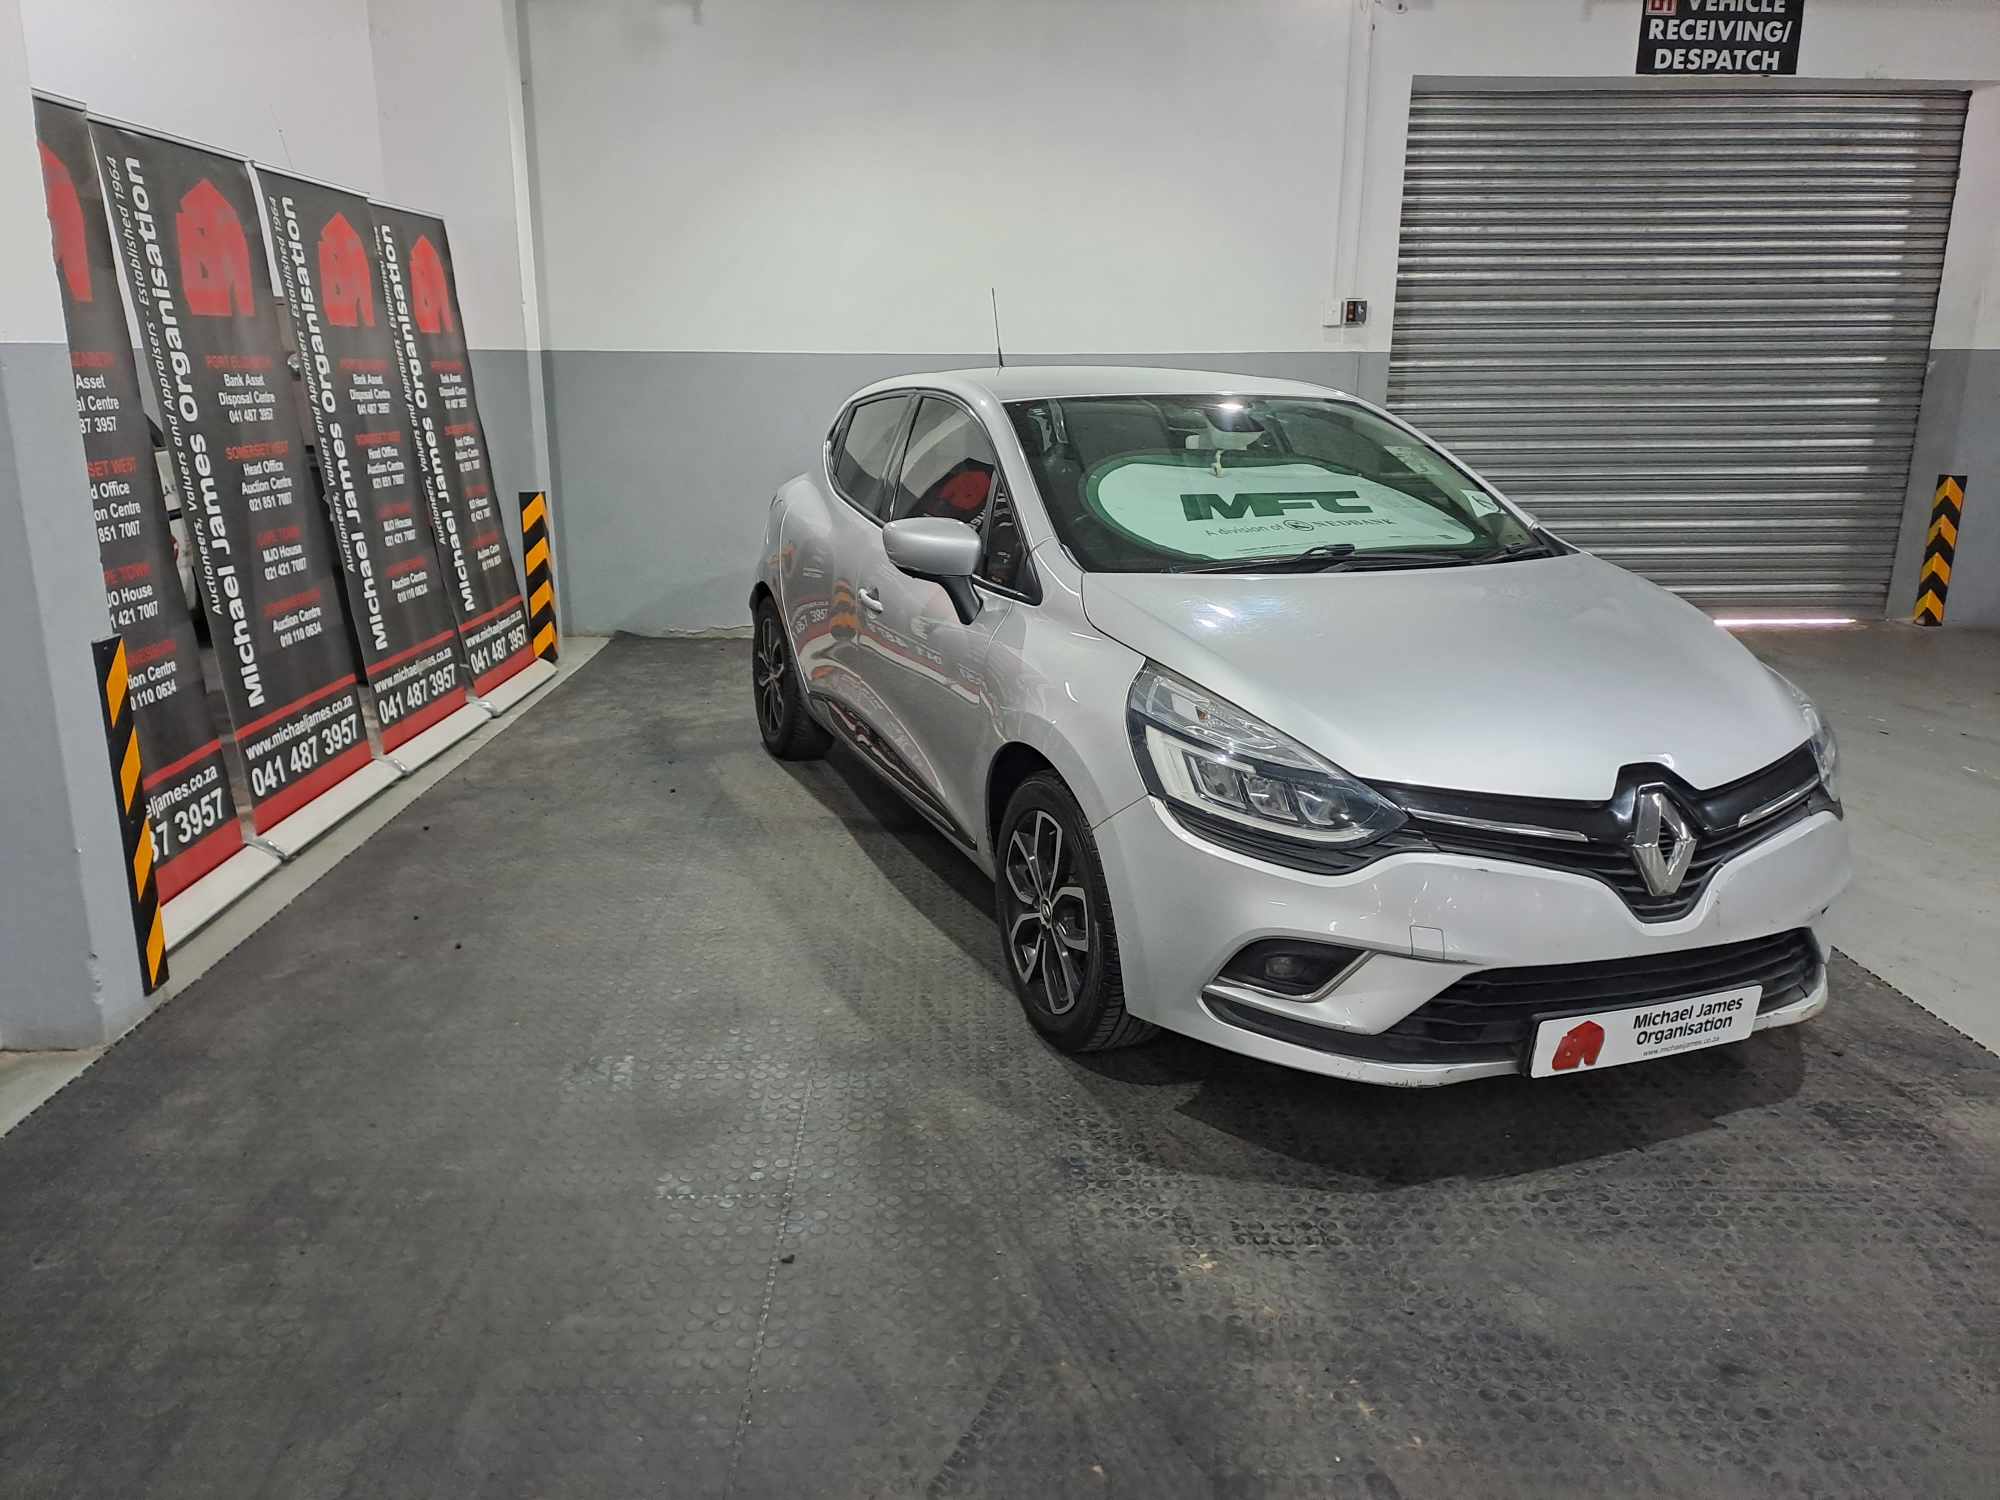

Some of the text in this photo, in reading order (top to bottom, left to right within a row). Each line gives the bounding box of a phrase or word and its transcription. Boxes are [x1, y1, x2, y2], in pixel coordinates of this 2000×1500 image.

[1689, 0, 1786, 13] VEHICLE
[1649, 19, 1792, 43] RECEIVING/
[1654, 49, 1781, 71] DESPATCH
[105, 155, 126, 200] 1964
[116, 204, 150, 307] Established
[281, 196, 337, 414] Organisation
[380, 224, 428, 410] Organisation
[76, 373, 106, 389] Asset
[224, 373, 244, 387] Bank
[87, 395, 120, 411] Centre
[218, 391, 253, 408] Disposal
[80, 416, 117, 434] 87 3957
[125, 156, 265, 708] Michael James Organisation
[166, 414, 183, 447] and
[229, 409, 243, 424] 041
[311, 406, 325, 433] and
[329, 422, 361, 524] James
[422, 417, 450, 504] James
[99, 481, 130, 498] Office
[176, 451, 198, 512] Valuers
[109, 501, 141, 518] Centre
[1180, 490, 1373, 521] MFC
[98, 520, 141, 543] 851 7007
[441, 510, 477, 612] Michael
[121, 584, 153, 604] House
[350, 532, 389, 650] Michael
[118, 609, 136, 626] 421
[136, 601, 159, 621] 7007
[470, 623, 527, 674] 041 487 3957
[127, 660, 176, 690] tion Centre
[136, 687, 154, 708] 110
[155, 679, 177, 700] 0634
[378, 663, 457, 725] 041 487 3957
[245, 694, 353, 761] www.michaeljames.co.za
[251, 713, 358, 797] 041 487 3957
[145, 766, 219, 819] eljames.co.za
[174, 787, 224, 843] 3957
[1633, 997, 1743, 1029] Michael James
[1636, 1016, 1733, 1045] Organisation
